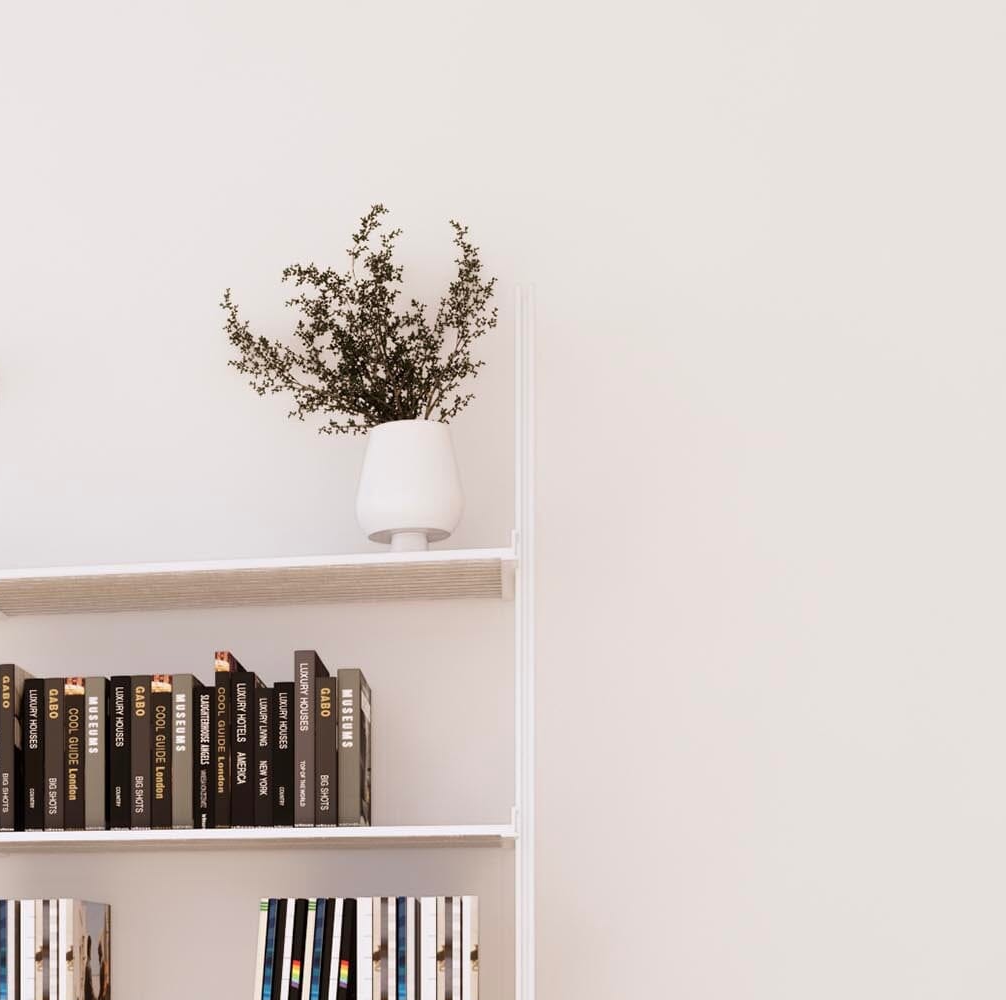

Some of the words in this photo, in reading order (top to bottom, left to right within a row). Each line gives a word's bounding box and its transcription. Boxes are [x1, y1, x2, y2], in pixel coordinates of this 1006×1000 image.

[2, 676, 10, 708] GABO
[300, 663, 308, 696] LUXURY
[29, 690, 37, 718] LUXURY
[49, 688, 58, 719] GABO
[116, 687, 124, 715] LUXURY
[136, 686, 145, 716] GABO
[218, 687, 226, 716] COOL
[237, 683, 246, 712] LUXURY
[279, 692, 287, 720] LUXURY
[320, 688, 330, 717] GABO
[68, 708, 78, 734] COOL
[88, 696, 98, 754] MUSEUMS
[156, 706, 166, 732] COOL
[176, 694, 186, 751] MUSEUMS
[237, 714, 246, 743] HOTELS
[300, 698, 308, 732] HOUSES
[342, 689, 353, 748] MUSEUMS
[29, 720, 37, 749] HOUSES
[116, 717, 124, 747] HOUSES
[218, 720, 226, 753] GUIDE
[279, 721, 287, 749] HOUSES
[68, 736, 78, 765] GUIDE
[156, 735, 166, 763] GUIDE
[135, 776, 144, 788] BIG
[156, 766, 165, 799] London
[237, 752, 246, 785] AMERICA
[259, 760, 268, 776] NEW
[320, 775, 329, 786] BIG
[48, 778, 57, 790] BIG
[68, 768, 78, 800] London
[259, 777, 268, 796] YORK
[48, 791, 57, 815] SHOTS
[135, 789, 144, 813] SHOTS
[320, 788, 329, 811] SHOTS
